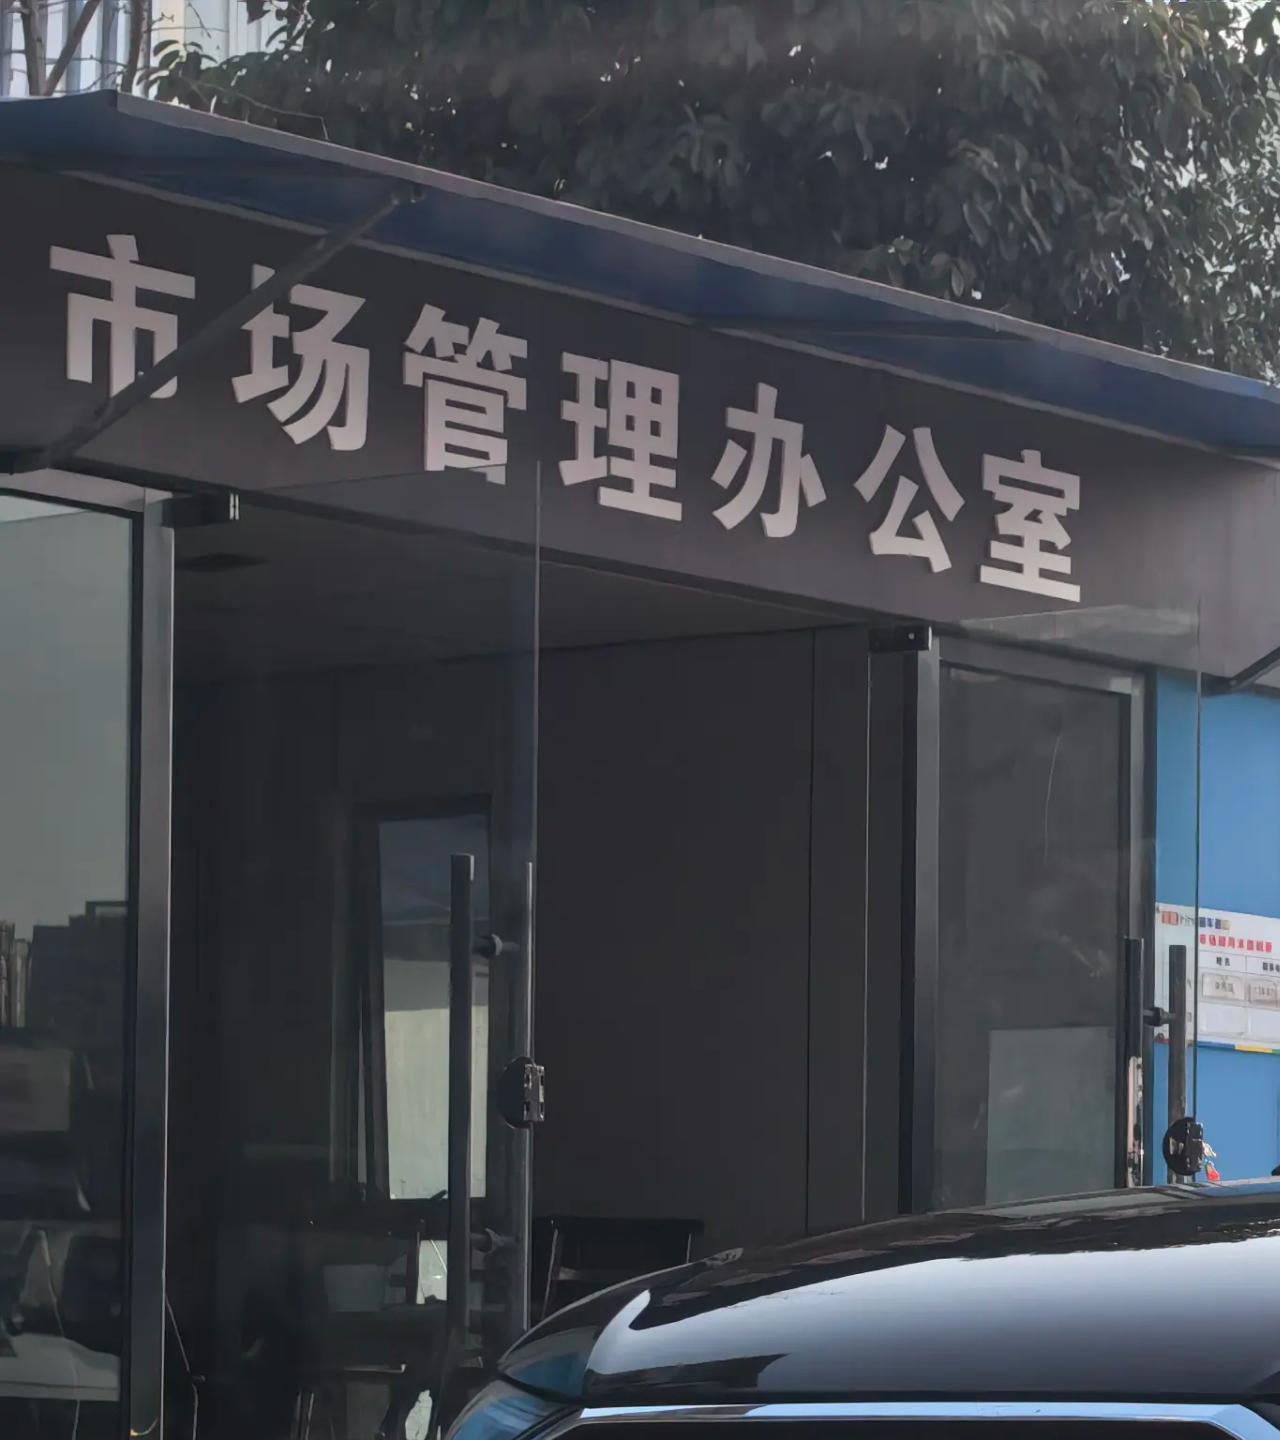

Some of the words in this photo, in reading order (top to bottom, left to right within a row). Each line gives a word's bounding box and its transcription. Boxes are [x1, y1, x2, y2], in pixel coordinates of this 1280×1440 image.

[50, 234, 1081, 602] 市场管理办公室
